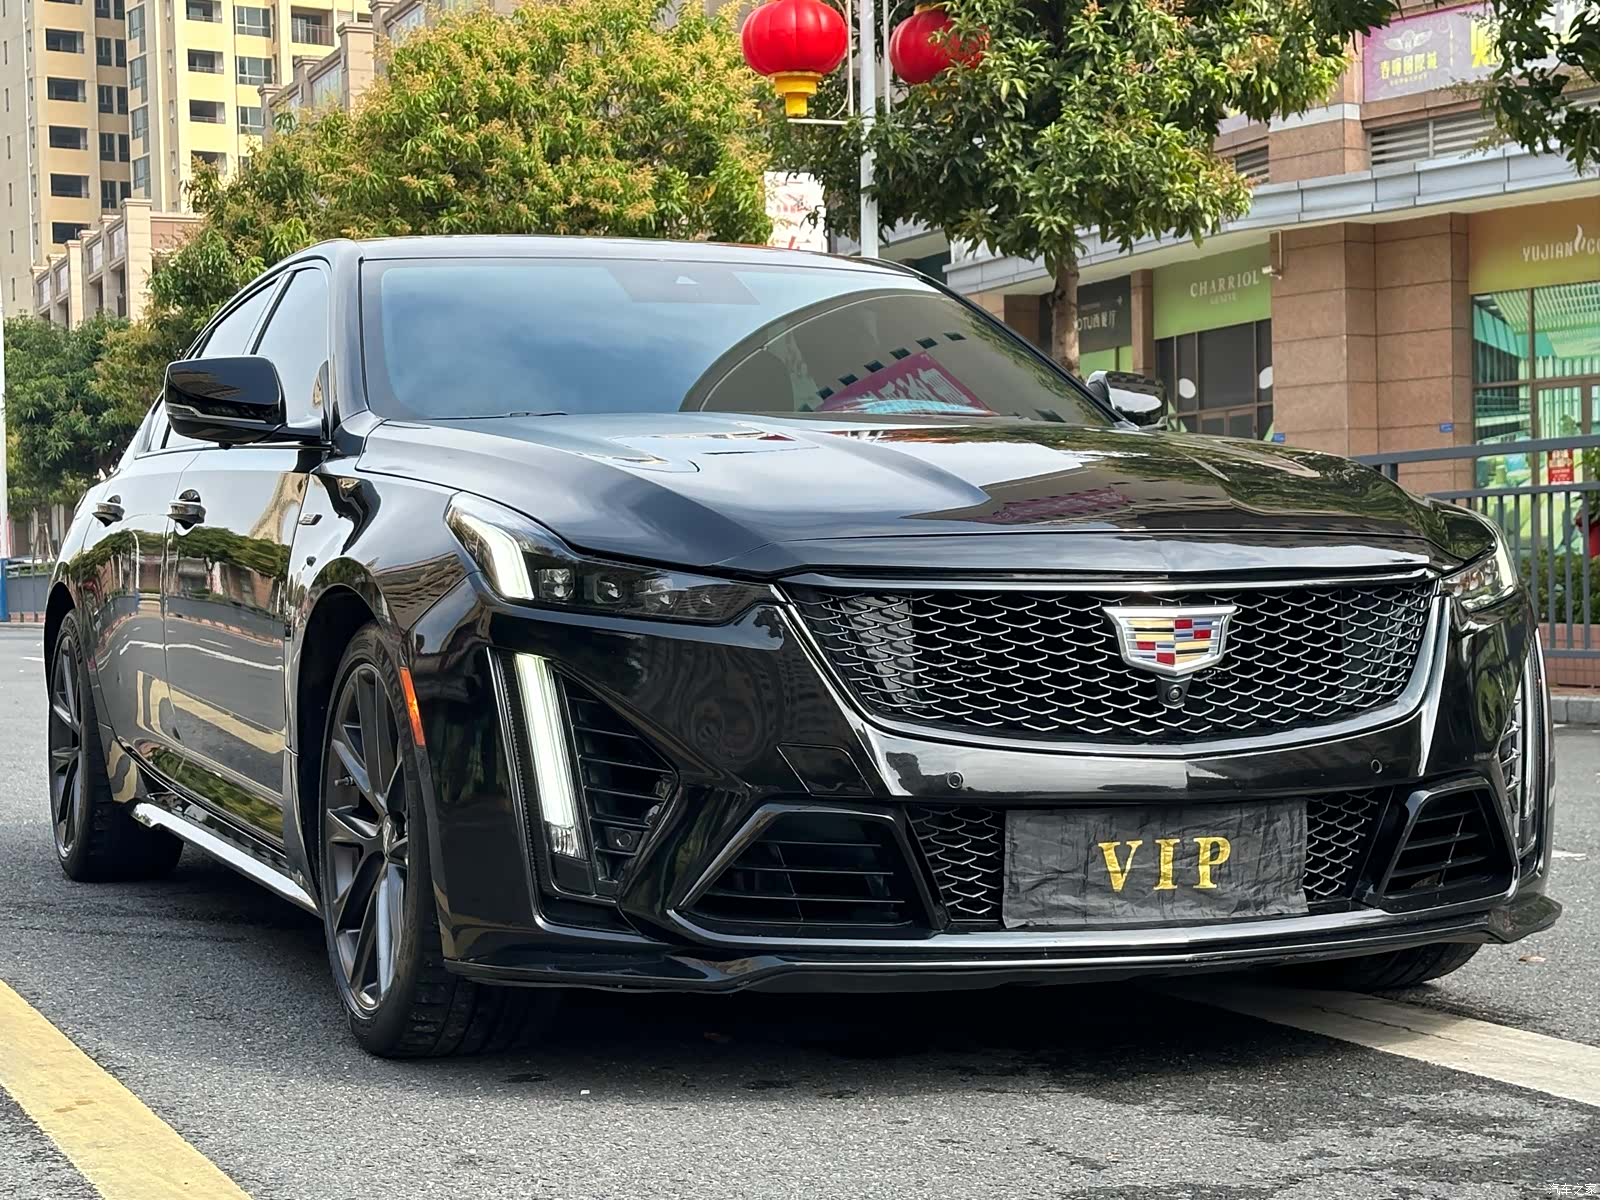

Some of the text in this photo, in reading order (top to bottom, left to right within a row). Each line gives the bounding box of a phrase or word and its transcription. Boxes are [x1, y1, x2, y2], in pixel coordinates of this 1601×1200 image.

[1522, 240, 1573, 262] YUJIAN
[1190, 269, 1260, 298] CHARRIOL
[1098, 836, 1232, 893] VIP
